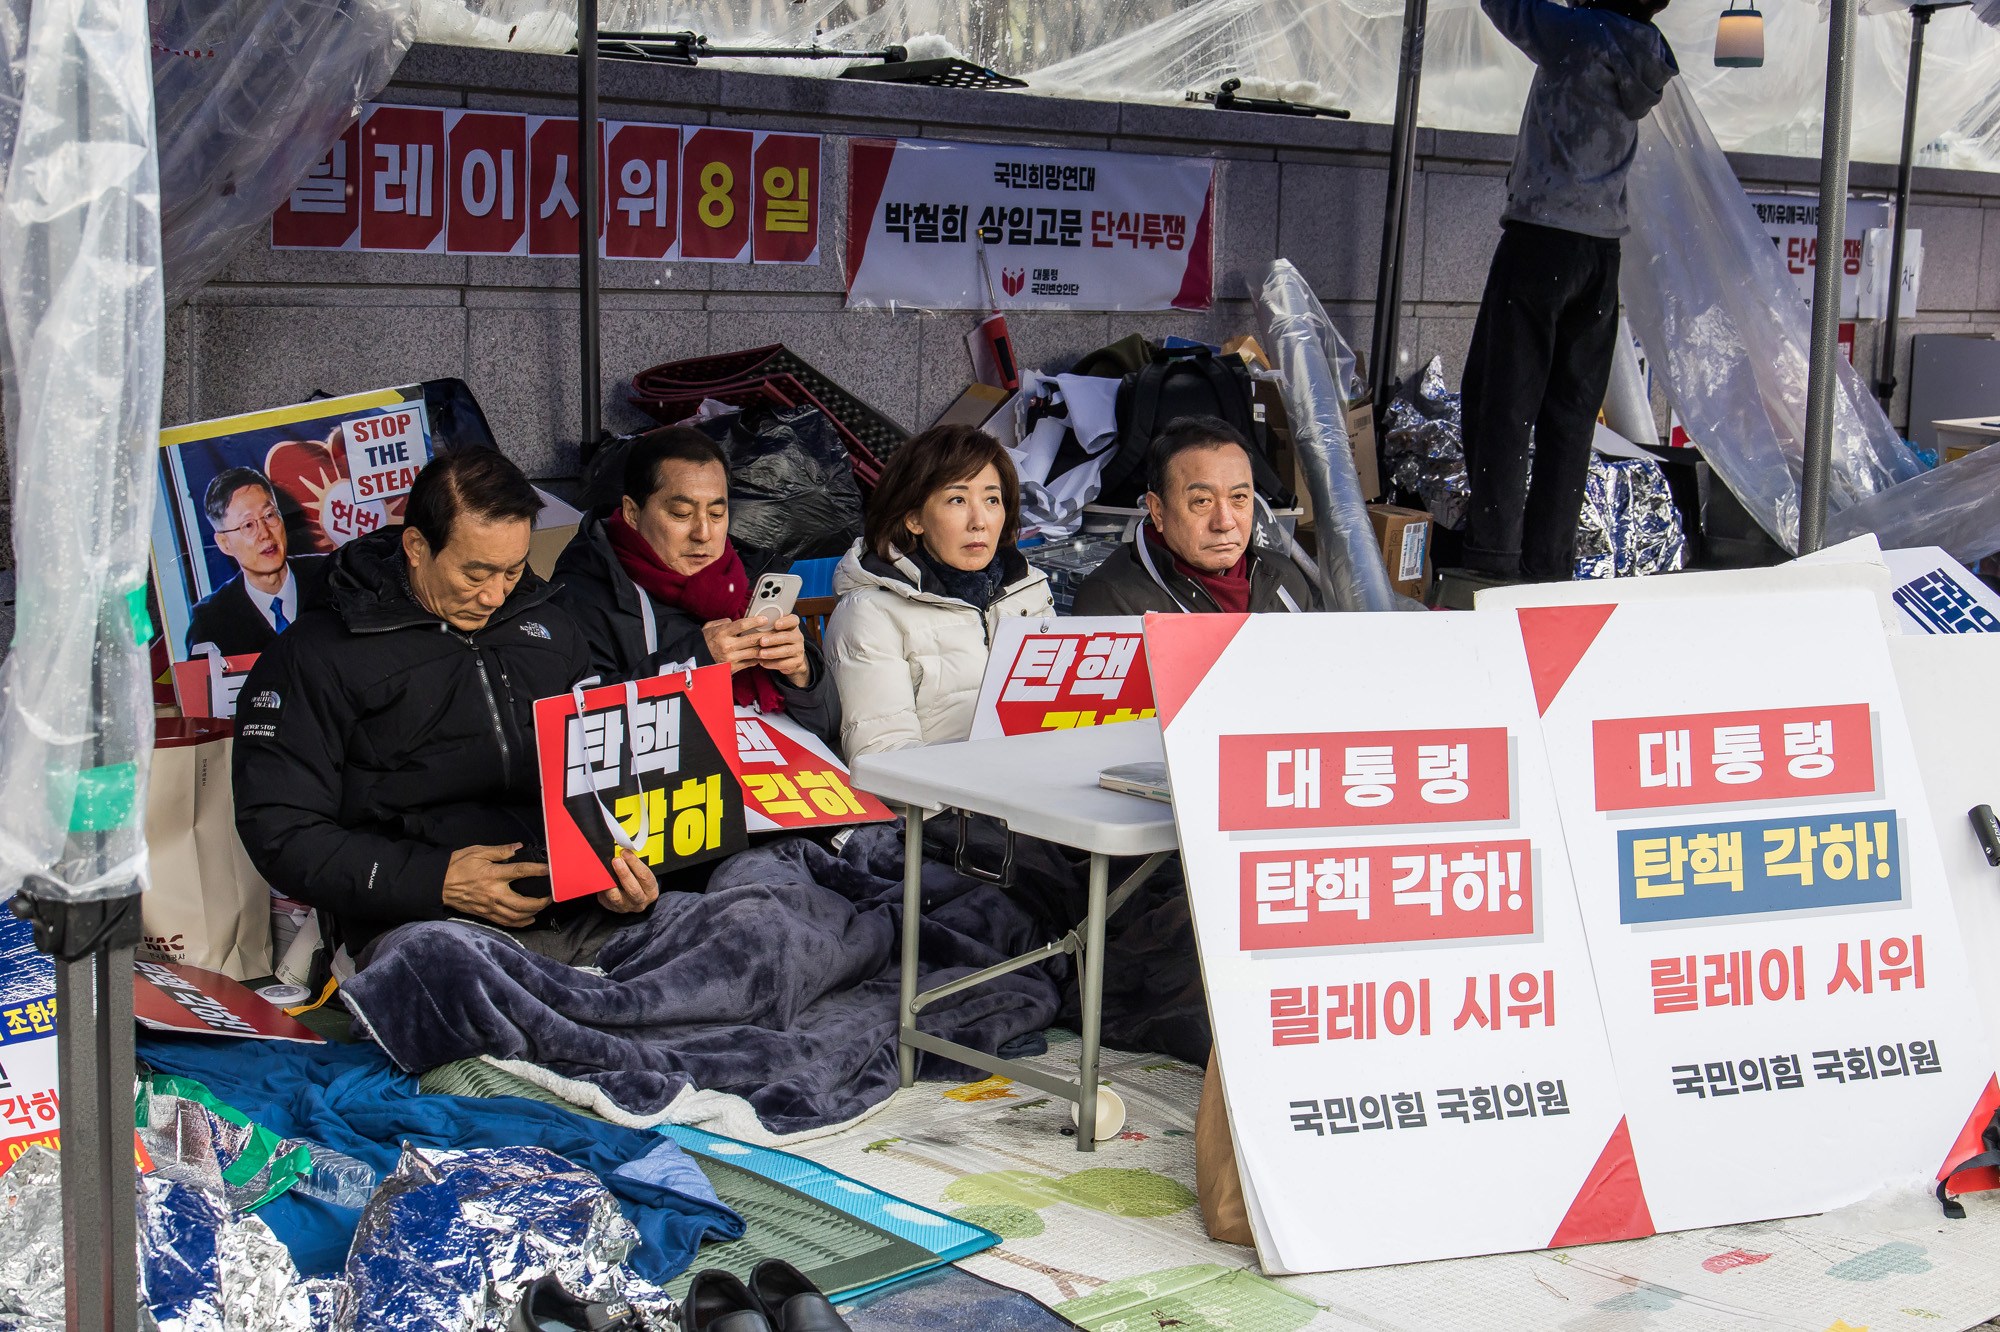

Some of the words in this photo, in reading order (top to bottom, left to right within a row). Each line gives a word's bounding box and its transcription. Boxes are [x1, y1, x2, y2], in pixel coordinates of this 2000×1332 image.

[698, 161, 809, 232] 8일
[994, 162, 1096, 191] 국민희망연대
[885, 202, 969, 243] 박철희
[977, 206, 1083, 247] 상임고문
[1091, 210, 1187, 251] 단식투쟁
[1031, 283, 1079, 295] 국민변호인단
[1033, 269, 1058, 281] 대통령
[353, 414, 411, 443] STOP
[365, 441, 409, 467] THE
[1001, 636, 1142, 701] 탄핵
[566, 696, 682, 798] 탄핵
[614, 773, 724, 867] 각하
[741, 770, 868, 819] 각하
[1255, 857, 1370, 925] 탄핵
[1391, 850, 1523, 917] 각하!
[1632, 831, 1745, 899] 탄핵
[1763, 821, 1891, 886] 각하!
[1650, 945, 1806, 1015] 릴레이
[1827, 934, 1926, 996] 시위
[173, 991, 259, 1033] 각하!
[1270, 978, 1431, 1047] 릴레이
[1453, 969, 1556, 1031] 시위
[1671, 1053, 1805, 1099] 국민의힘
[1811, 1039, 1943, 1085] 국회의원
[1289, 1091, 1428, 1137] 국민의힘
[1436, 1079, 1571, 1125] 국회의원
